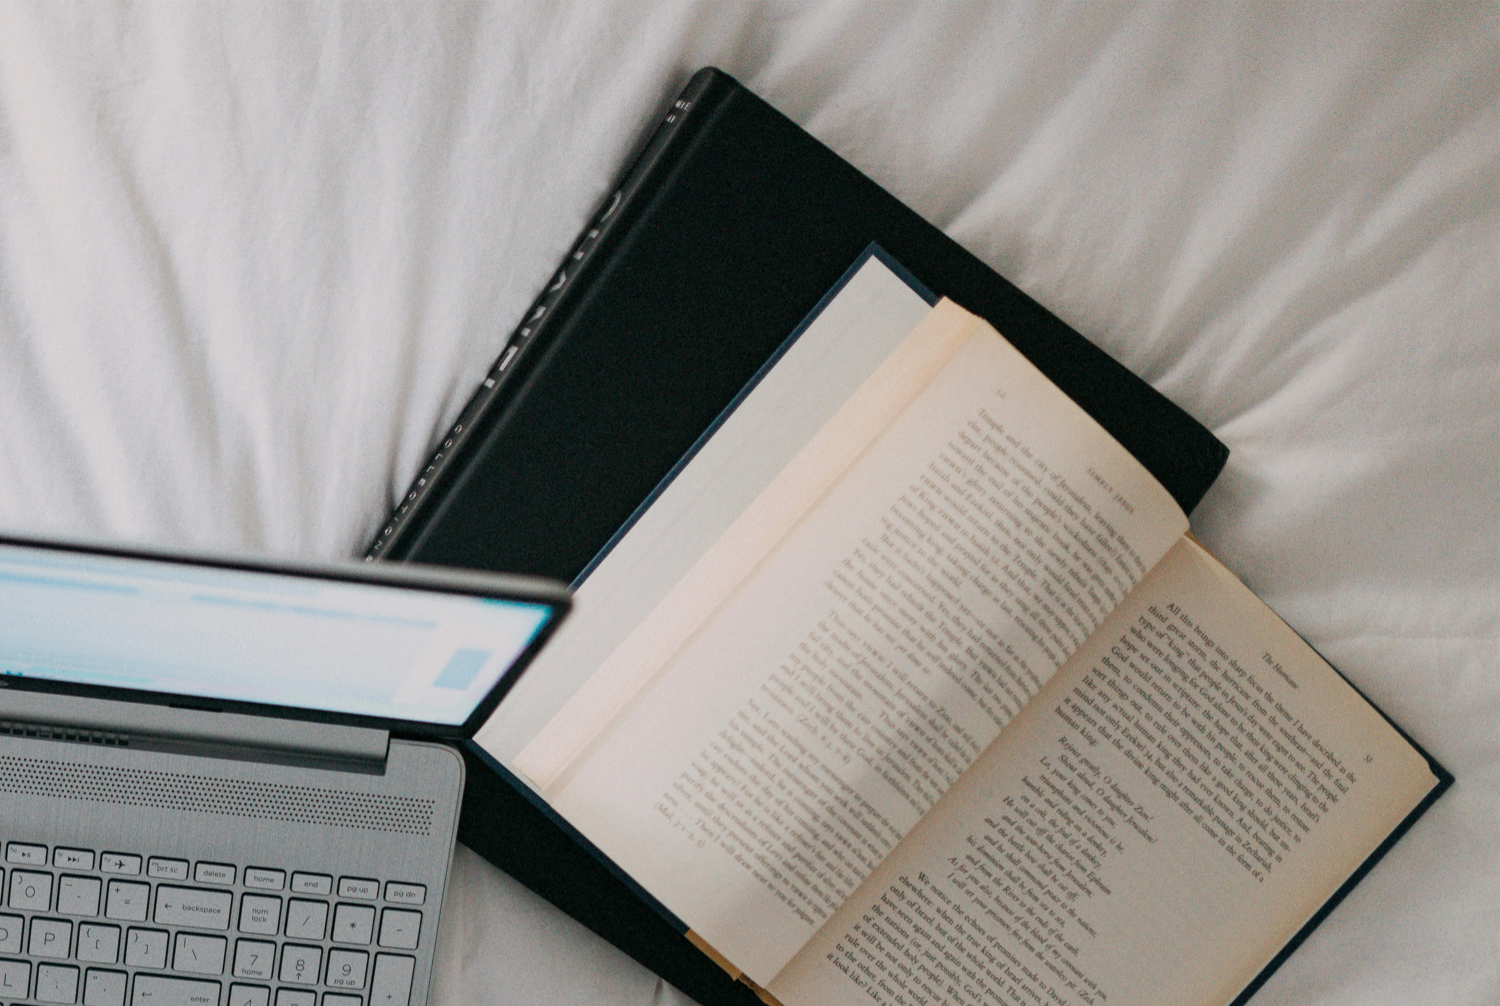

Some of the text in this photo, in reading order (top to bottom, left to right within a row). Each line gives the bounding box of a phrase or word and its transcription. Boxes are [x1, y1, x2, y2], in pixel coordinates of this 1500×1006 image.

[1261, 650, 1300, 690] The Hurricane
[1002, 795, 1112, 896] He will cut off the chariot from Ephraim
[202, 870, 226, 878] delete
[24, 885, 35, 898] 0
[181, 903, 221, 913] backspace
[43, 931, 55, 945] P
[3, 972, 12, 987] L
